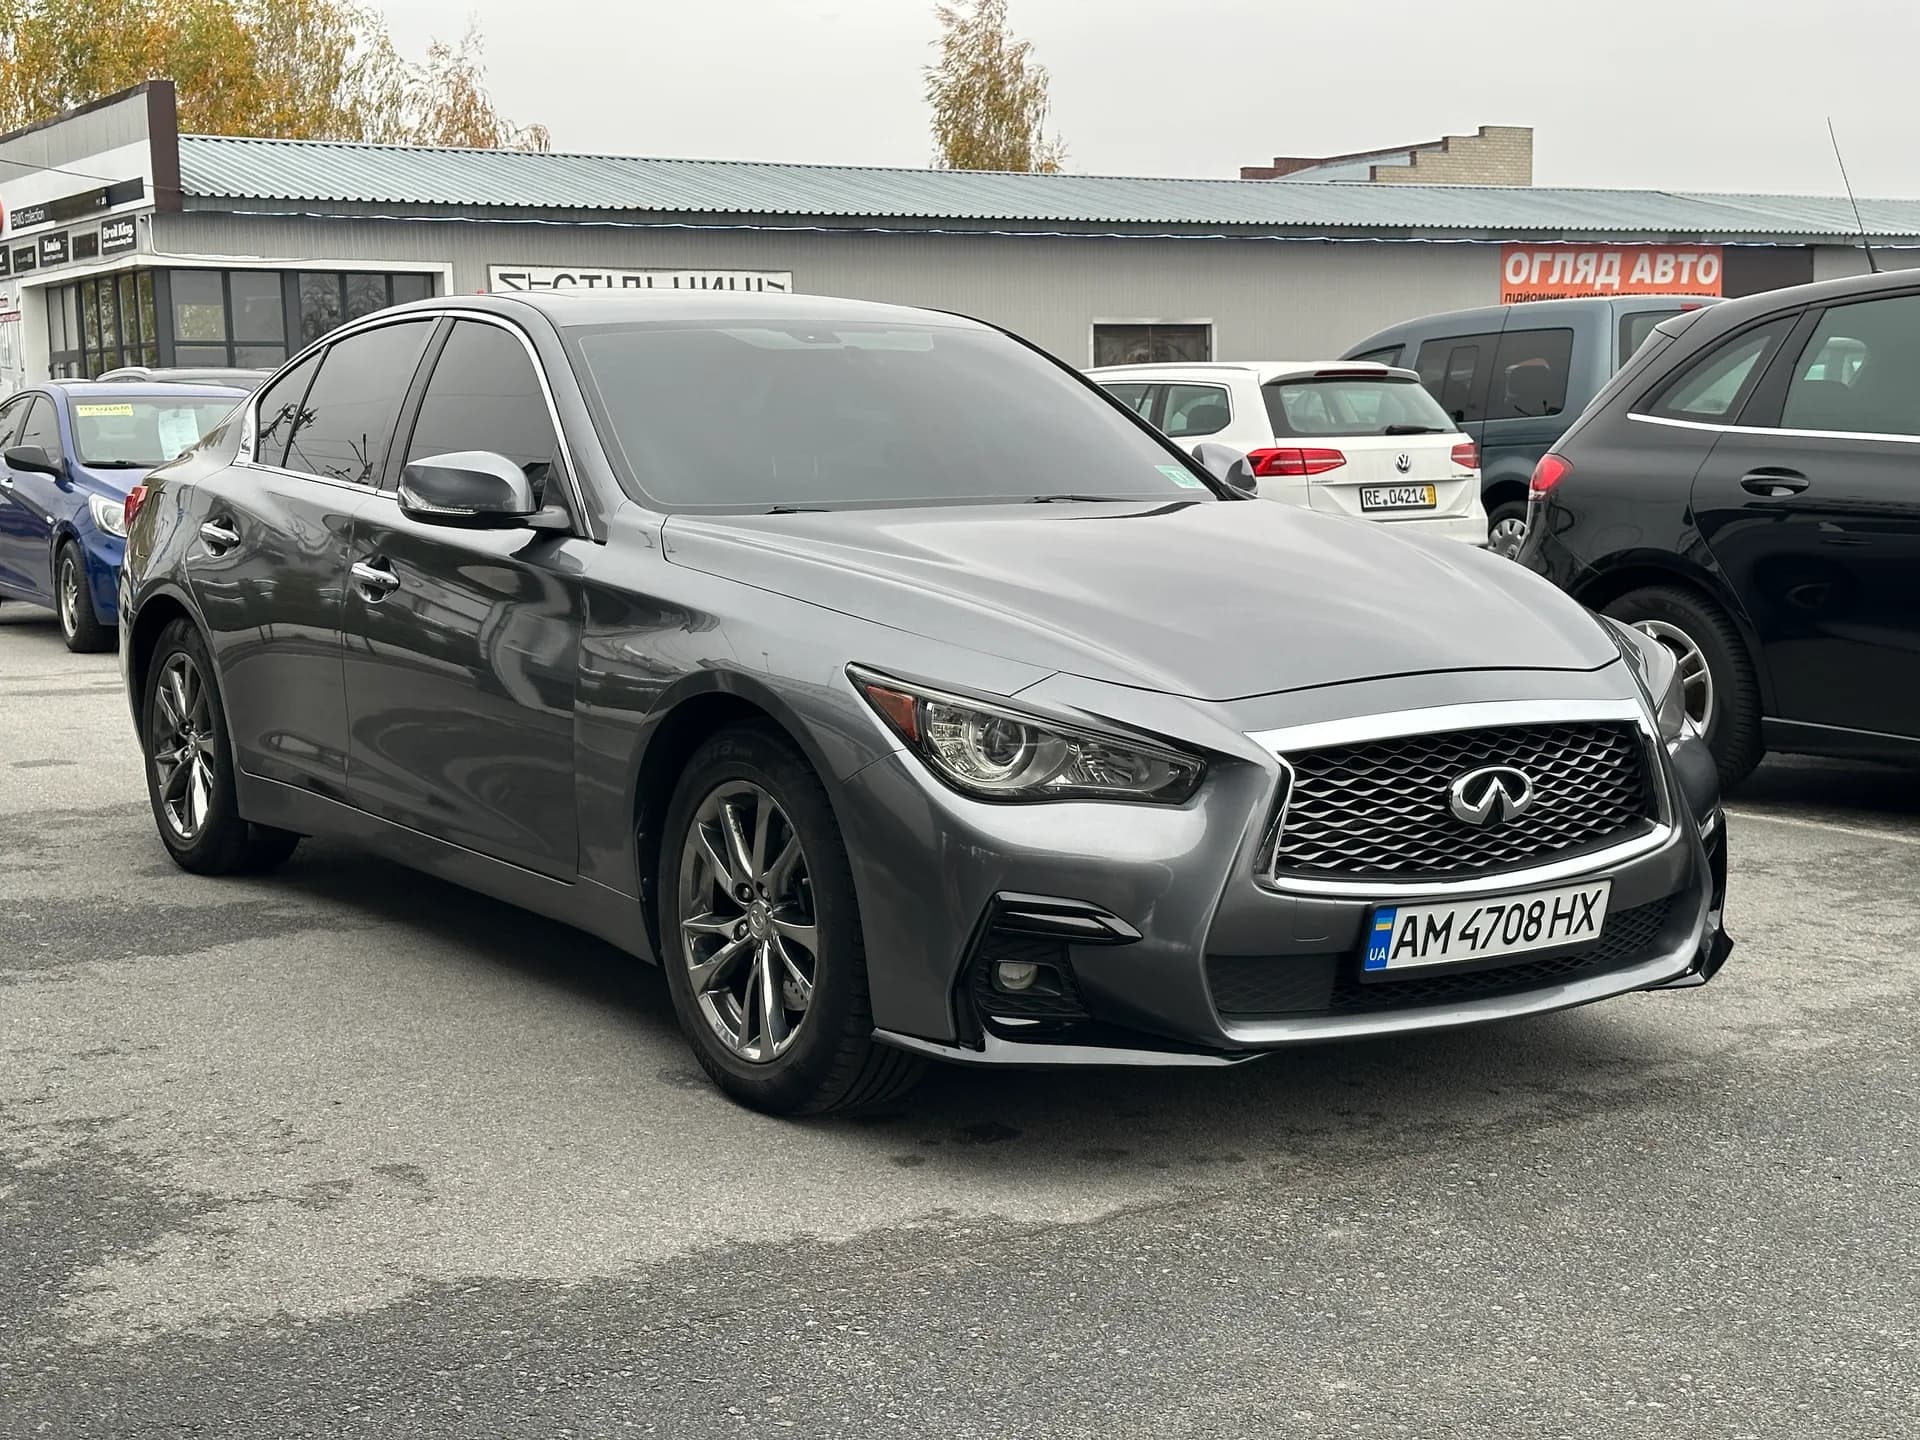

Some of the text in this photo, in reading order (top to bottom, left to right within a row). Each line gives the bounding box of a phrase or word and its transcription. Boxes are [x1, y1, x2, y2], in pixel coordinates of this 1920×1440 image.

[1505, 252, 1719, 290] ОГЛЯД АВТО
[1391, 889, 1603, 960] AM 4708 HX
[1369, 947, 1386, 961] UA
